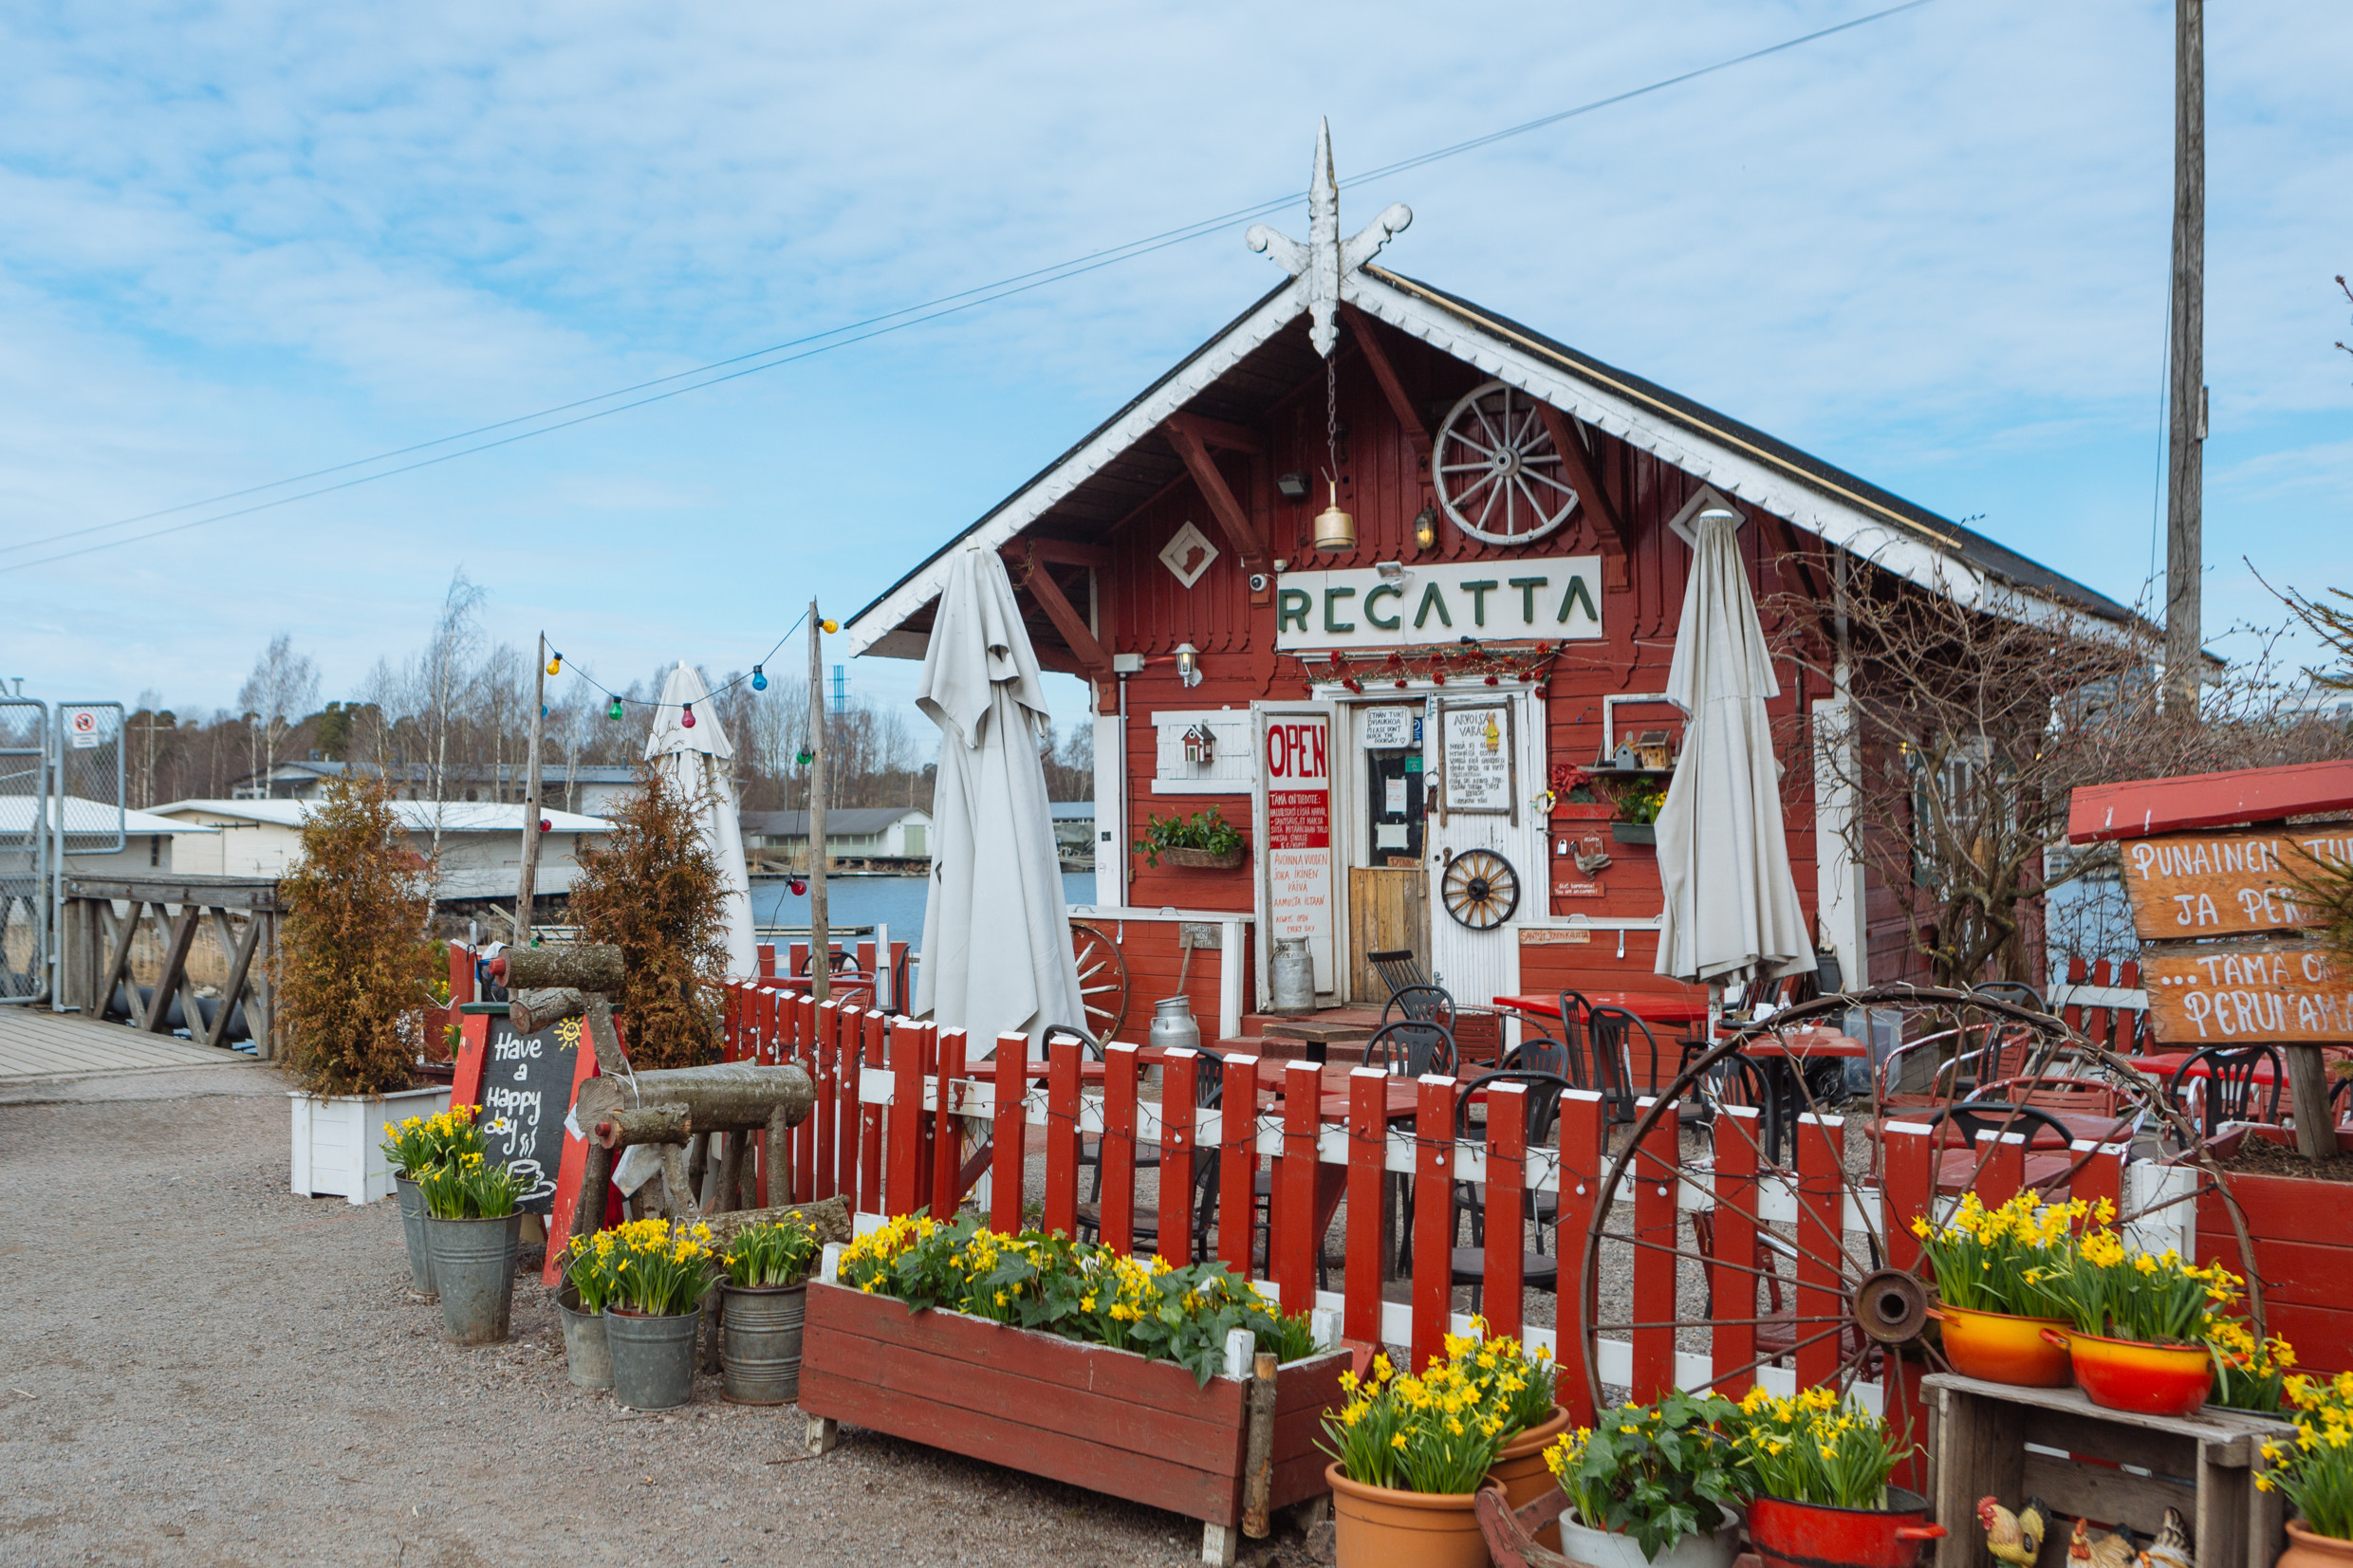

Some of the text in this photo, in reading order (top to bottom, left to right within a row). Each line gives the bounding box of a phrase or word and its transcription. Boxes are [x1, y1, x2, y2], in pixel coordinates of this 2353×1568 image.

[1278, 576, 1598, 633] REGATTA
[1268, 724, 1326, 778] OPEN
[1269, 793, 1321, 805] TÄMÄ ON TIEDOTE:
[1274, 852, 1328, 866] AVOINNA VUODEN
[2131, 839, 2353, 881] PUNAINEN TU
[1294, 867, 1319, 879] IKINEN
[1288, 880, 1308, 893] PÄIVÄ
[1273, 894, 1325, 908] AAMUSTA ILTAAN
[2173, 893, 2219, 927] JA
[1275, 914, 1294, 923] ALWAYS
[1185, 924, 1213, 933] SANTSIT
[1287, 925, 1303, 933] EVERY
[494, 1032, 543, 1061] Have
[513, 1062, 528, 1081] a
[486, 1086, 542, 1126] Happy
[483, 1110, 518, 1155] day
